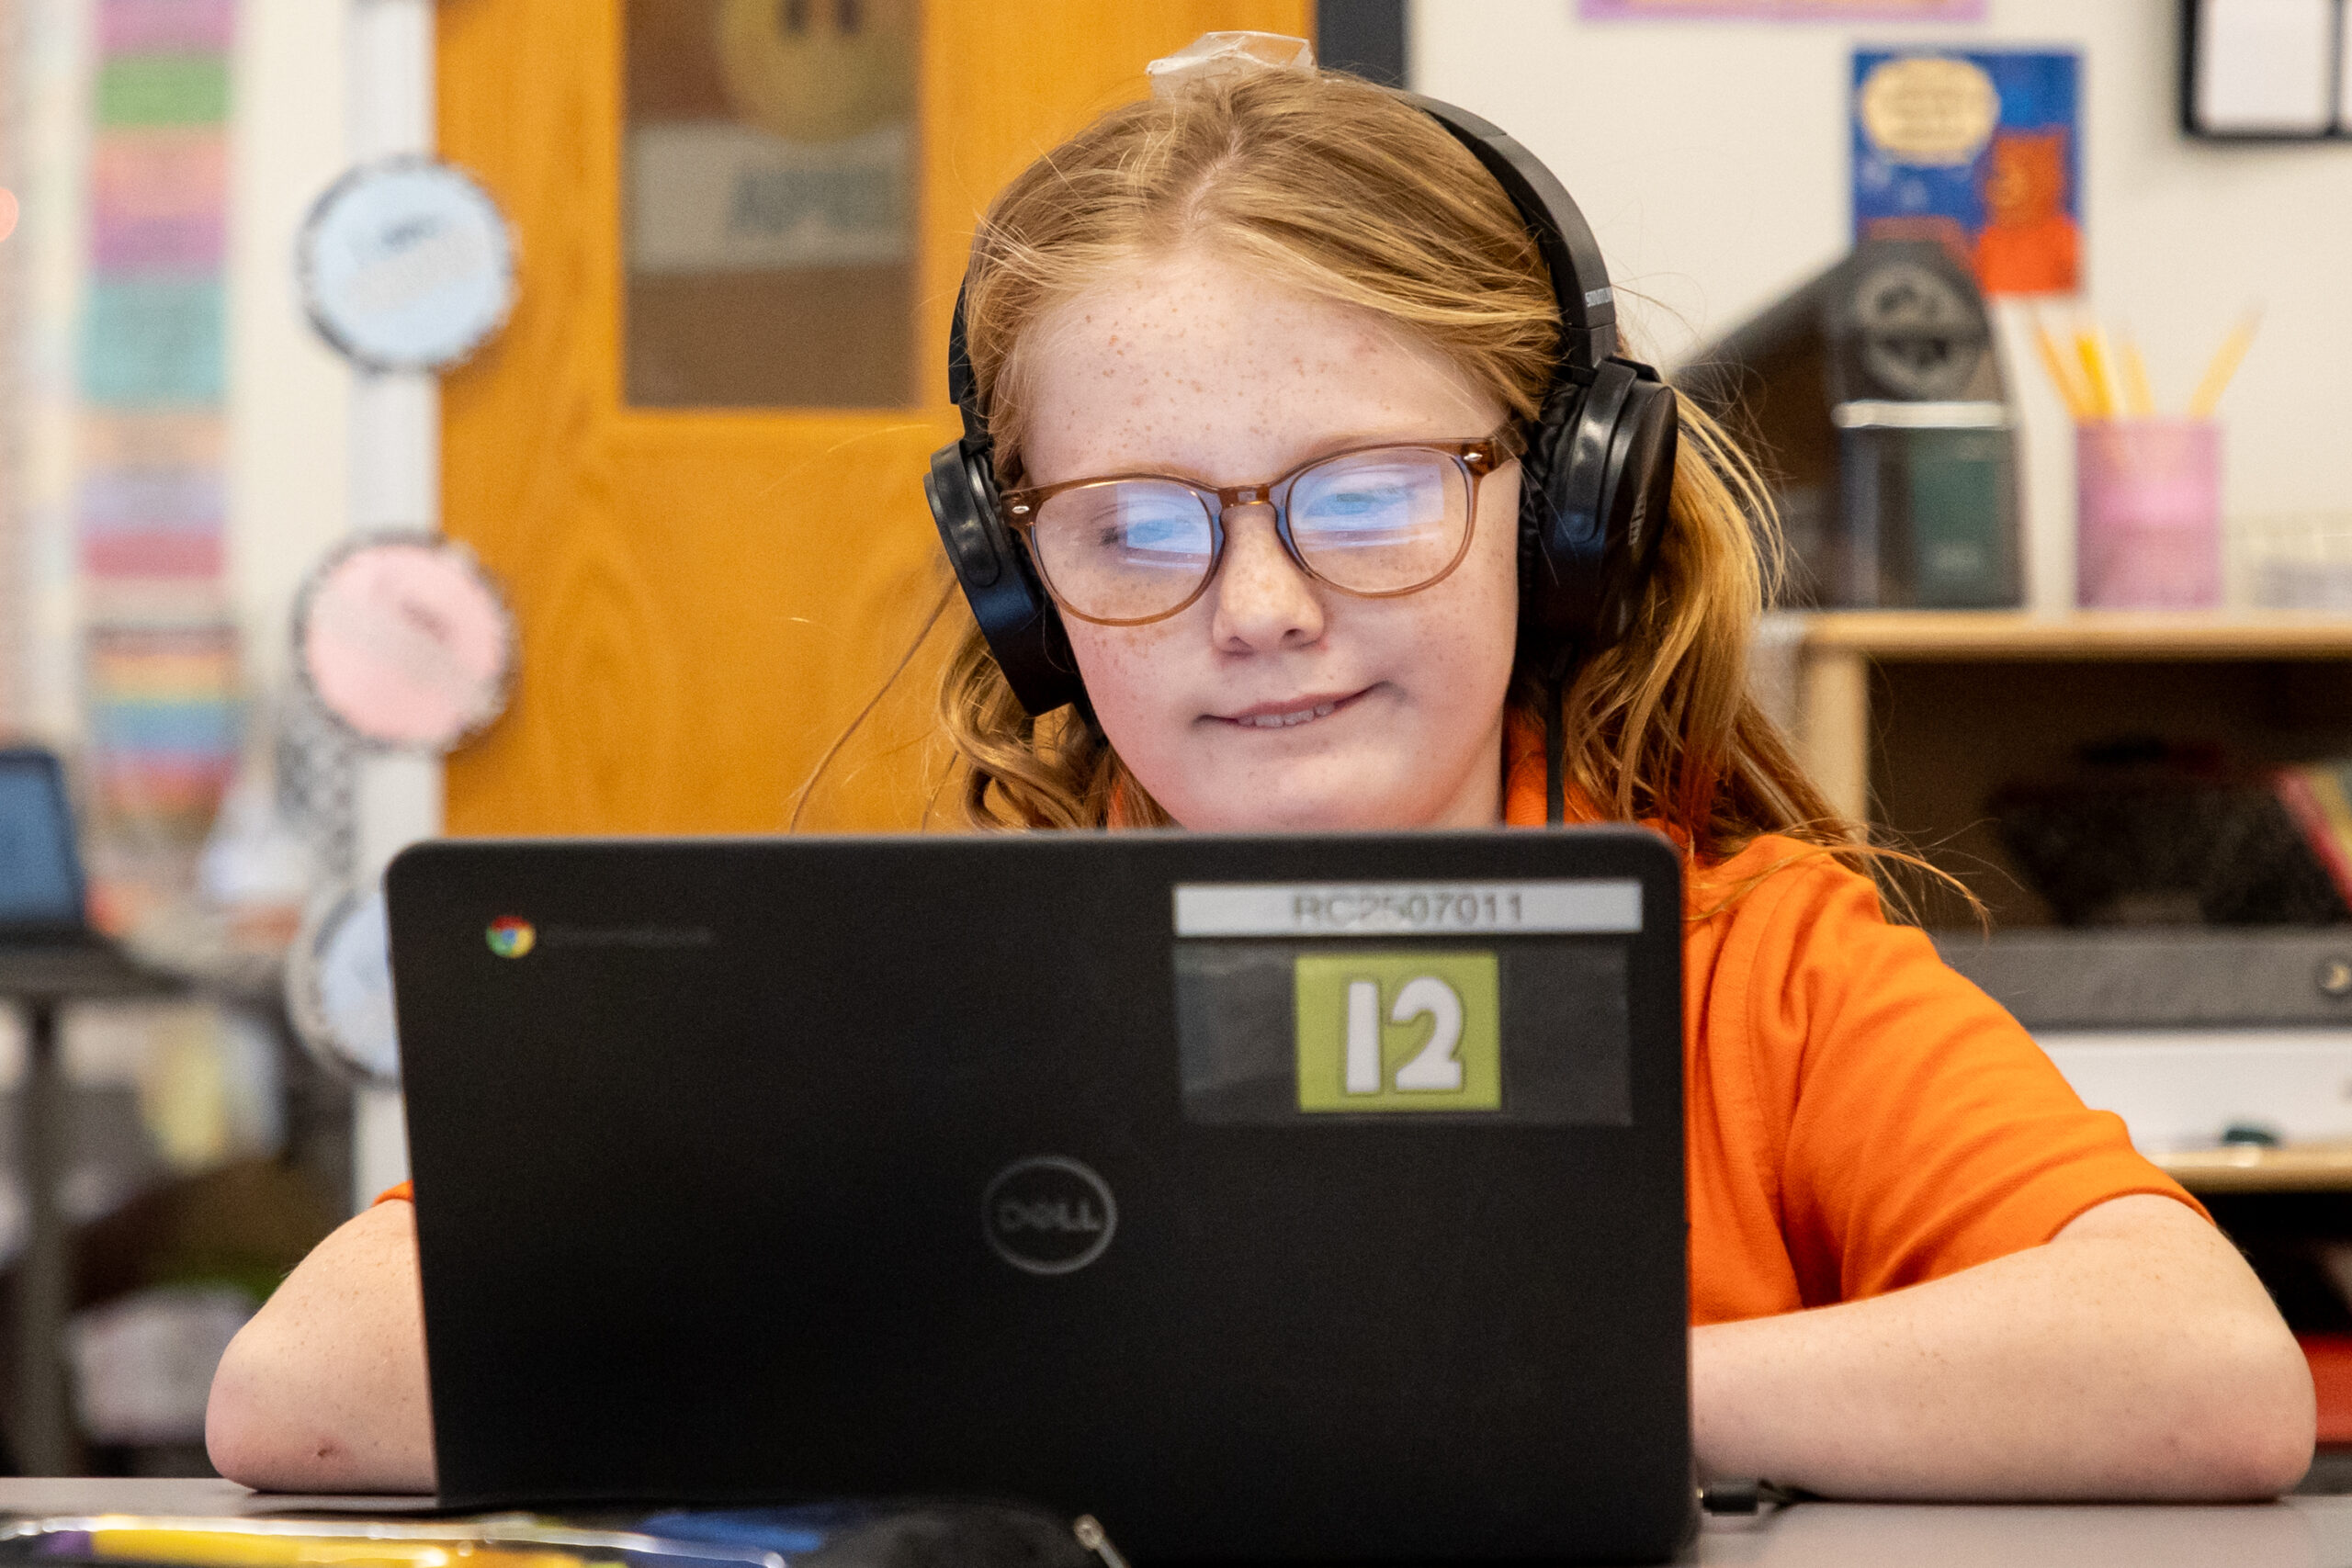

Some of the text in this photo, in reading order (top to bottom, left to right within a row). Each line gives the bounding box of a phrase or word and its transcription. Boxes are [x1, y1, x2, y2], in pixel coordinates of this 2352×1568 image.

[1293, 894, 1522, 924] RC2507011
[1344, 975, 1464, 1094] 12
[999, 1198, 1101, 1232] DELL
